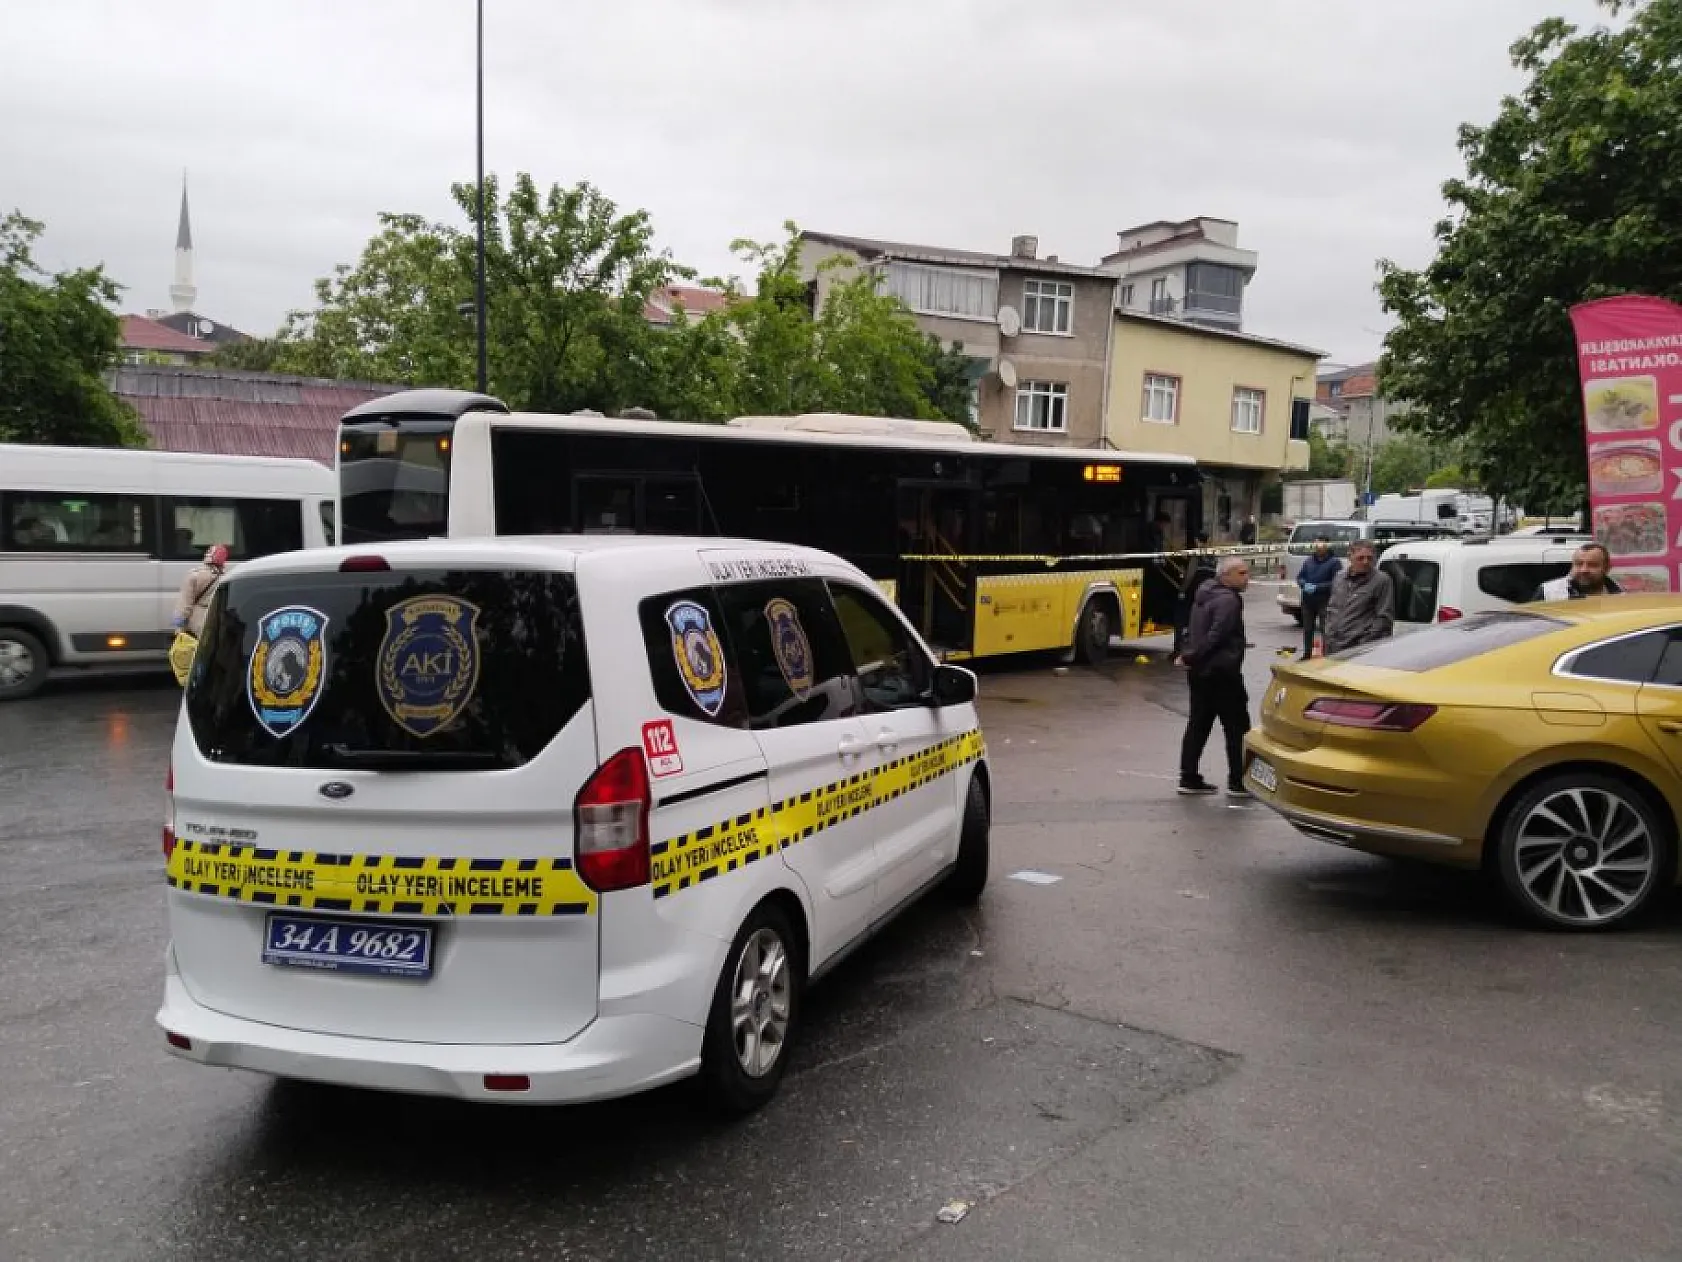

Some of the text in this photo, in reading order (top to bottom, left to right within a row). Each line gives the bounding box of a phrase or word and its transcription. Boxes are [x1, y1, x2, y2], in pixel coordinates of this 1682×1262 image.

[648, 726, 673, 754] 112
[184, 857, 211, 877] OLAY
[653, 854, 682, 881] OLAY
[356, 873, 399, 896] OLAY
[275, 924, 421, 960] 34 A 9682
